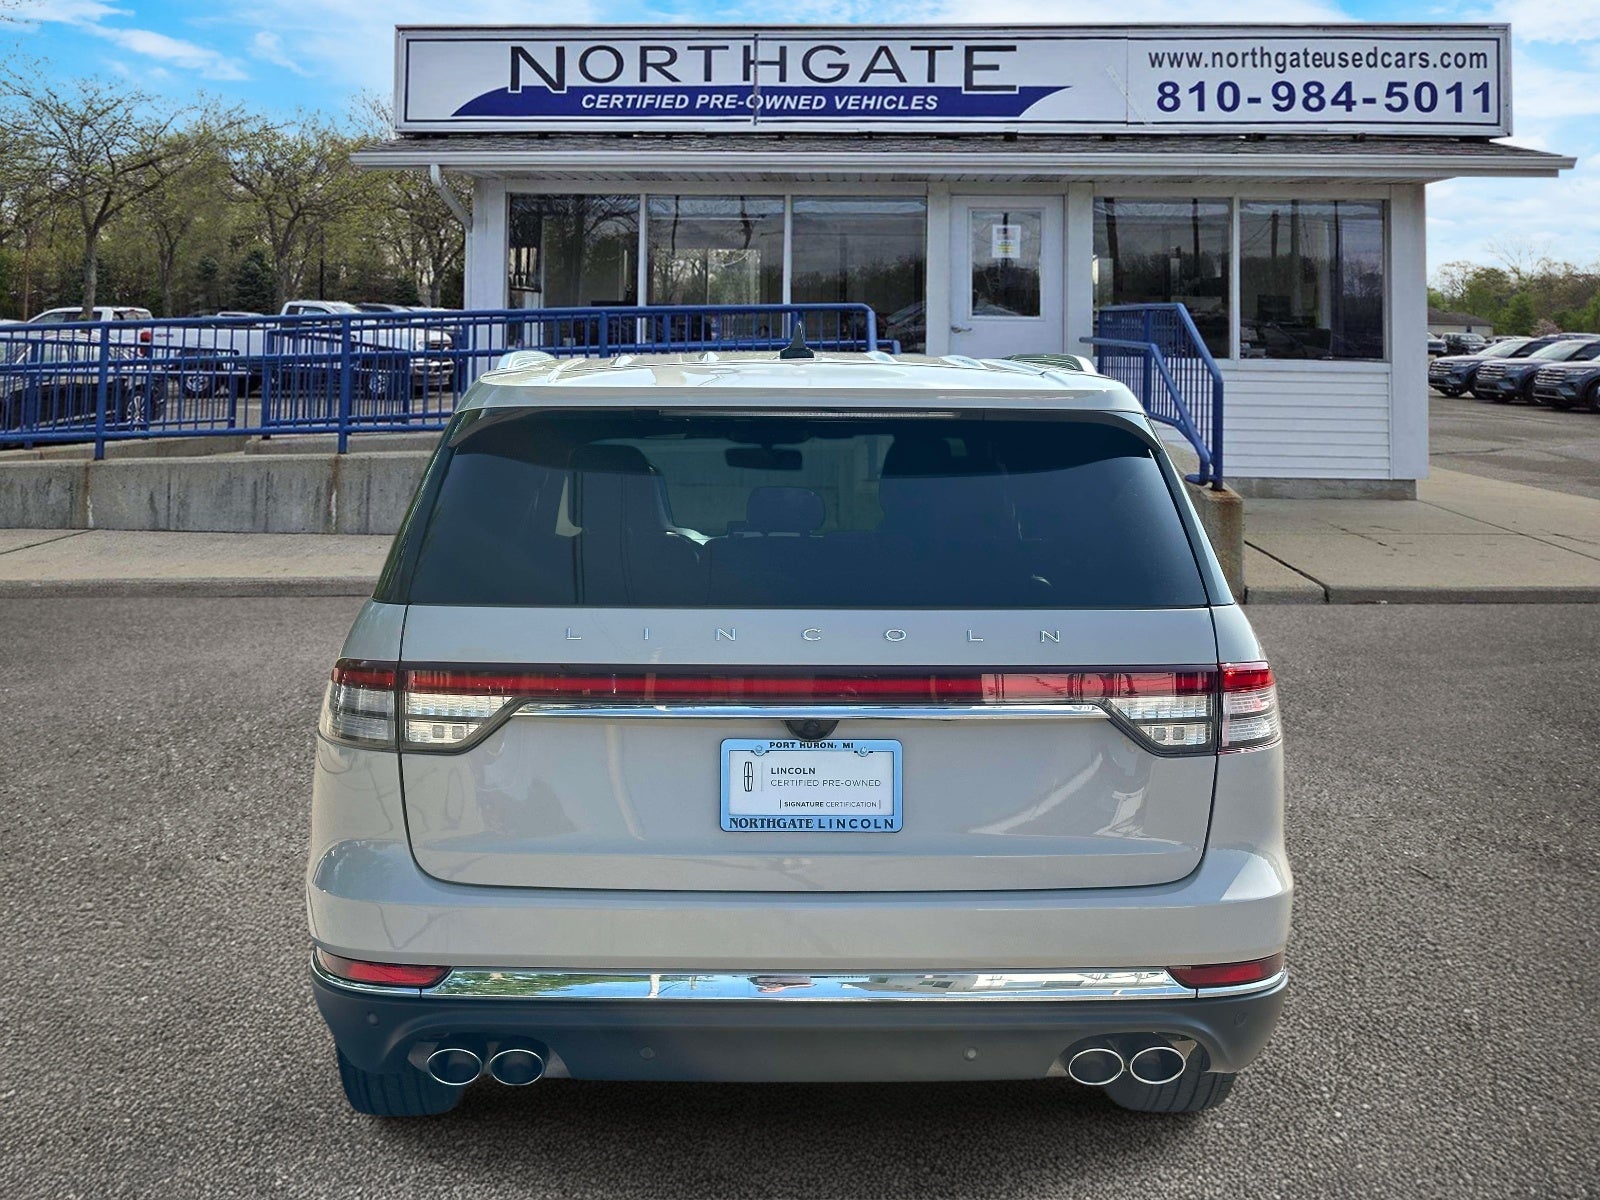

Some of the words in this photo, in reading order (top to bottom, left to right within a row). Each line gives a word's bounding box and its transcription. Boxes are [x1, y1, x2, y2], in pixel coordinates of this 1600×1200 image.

[1148, 46, 1489, 73] www.northgateusedcars.com
[508, 44, 1018, 94] NORTHGATE
[580, 93, 690, 112] CERTIFIED
[694, 93, 827, 111] PRE-OWNED
[833, 94, 939, 112] VEHICLES
[1156, 80, 1491, 114] 810-984-5011
[565, 627, 1061, 643] LINCOLN
[769, 741, 796, 749] PORT
[770, 767, 816, 775] LINCOLN
[770, 779, 820, 787] CERTIFIED
[822, 779, 882, 787] PRE-OWNED
[729, 818, 814, 829] NORTHGATE
[818, 819, 895, 829] LINCOLN
